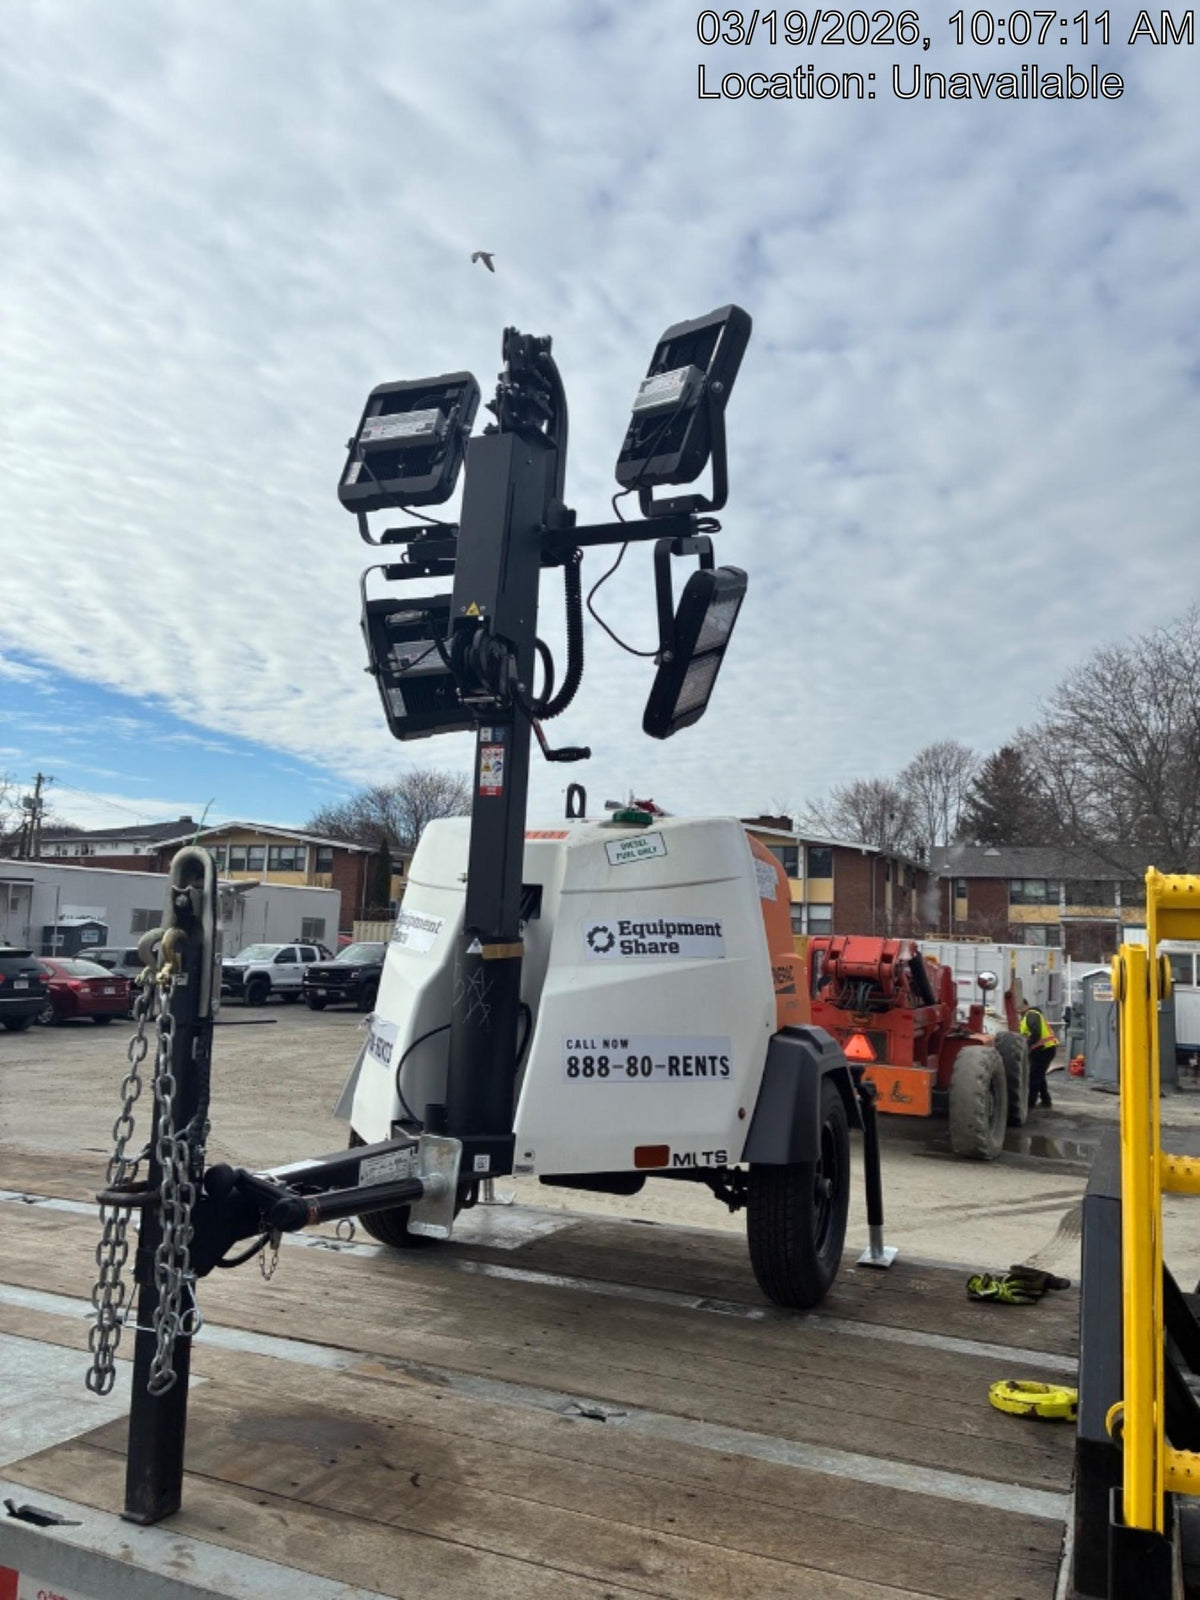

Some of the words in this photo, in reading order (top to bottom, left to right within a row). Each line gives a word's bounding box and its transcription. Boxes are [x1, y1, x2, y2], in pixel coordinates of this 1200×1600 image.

[617, 918, 723, 939] Equipment
[620, 939, 680, 956] Share
[566, 1039, 598, 1050] CALL
[602, 1039, 629, 1050] NOW
[566, 1055, 731, 1079] 888-80-RENTS
